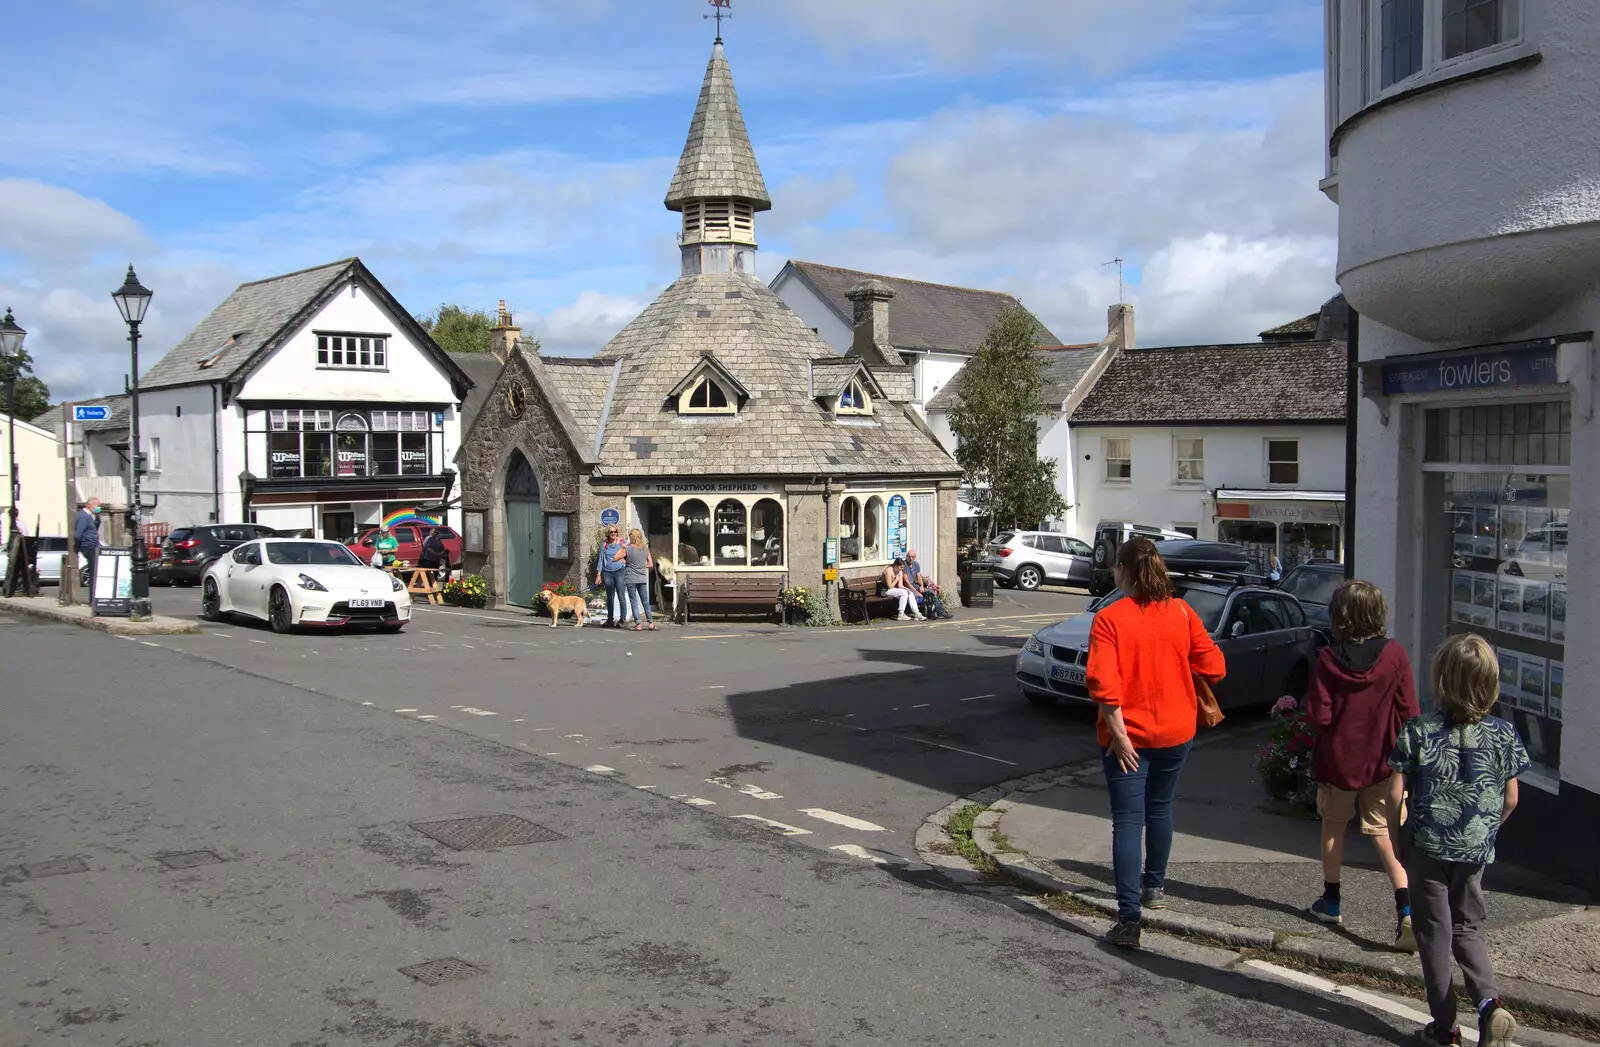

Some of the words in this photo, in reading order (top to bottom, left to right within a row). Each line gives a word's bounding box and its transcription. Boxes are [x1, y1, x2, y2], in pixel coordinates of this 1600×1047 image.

[1409, 369, 1428, 380] AGENT
[1438, 356, 1511, 387] fowlers
[272, 452, 299, 462] Whites
[337, 451, 365, 461] Whites
[401, 451, 425, 460] Whites
[718, 483, 758, 491] SHEPHERD
[1253, 506, 1317, 518] NEWSAGENTS
[351, 599, 369, 607] FL69
[370, 599, 383, 607] VNB
[1055, 668, 1069, 679] 687
[1070, 671, 1085, 682] RAX
